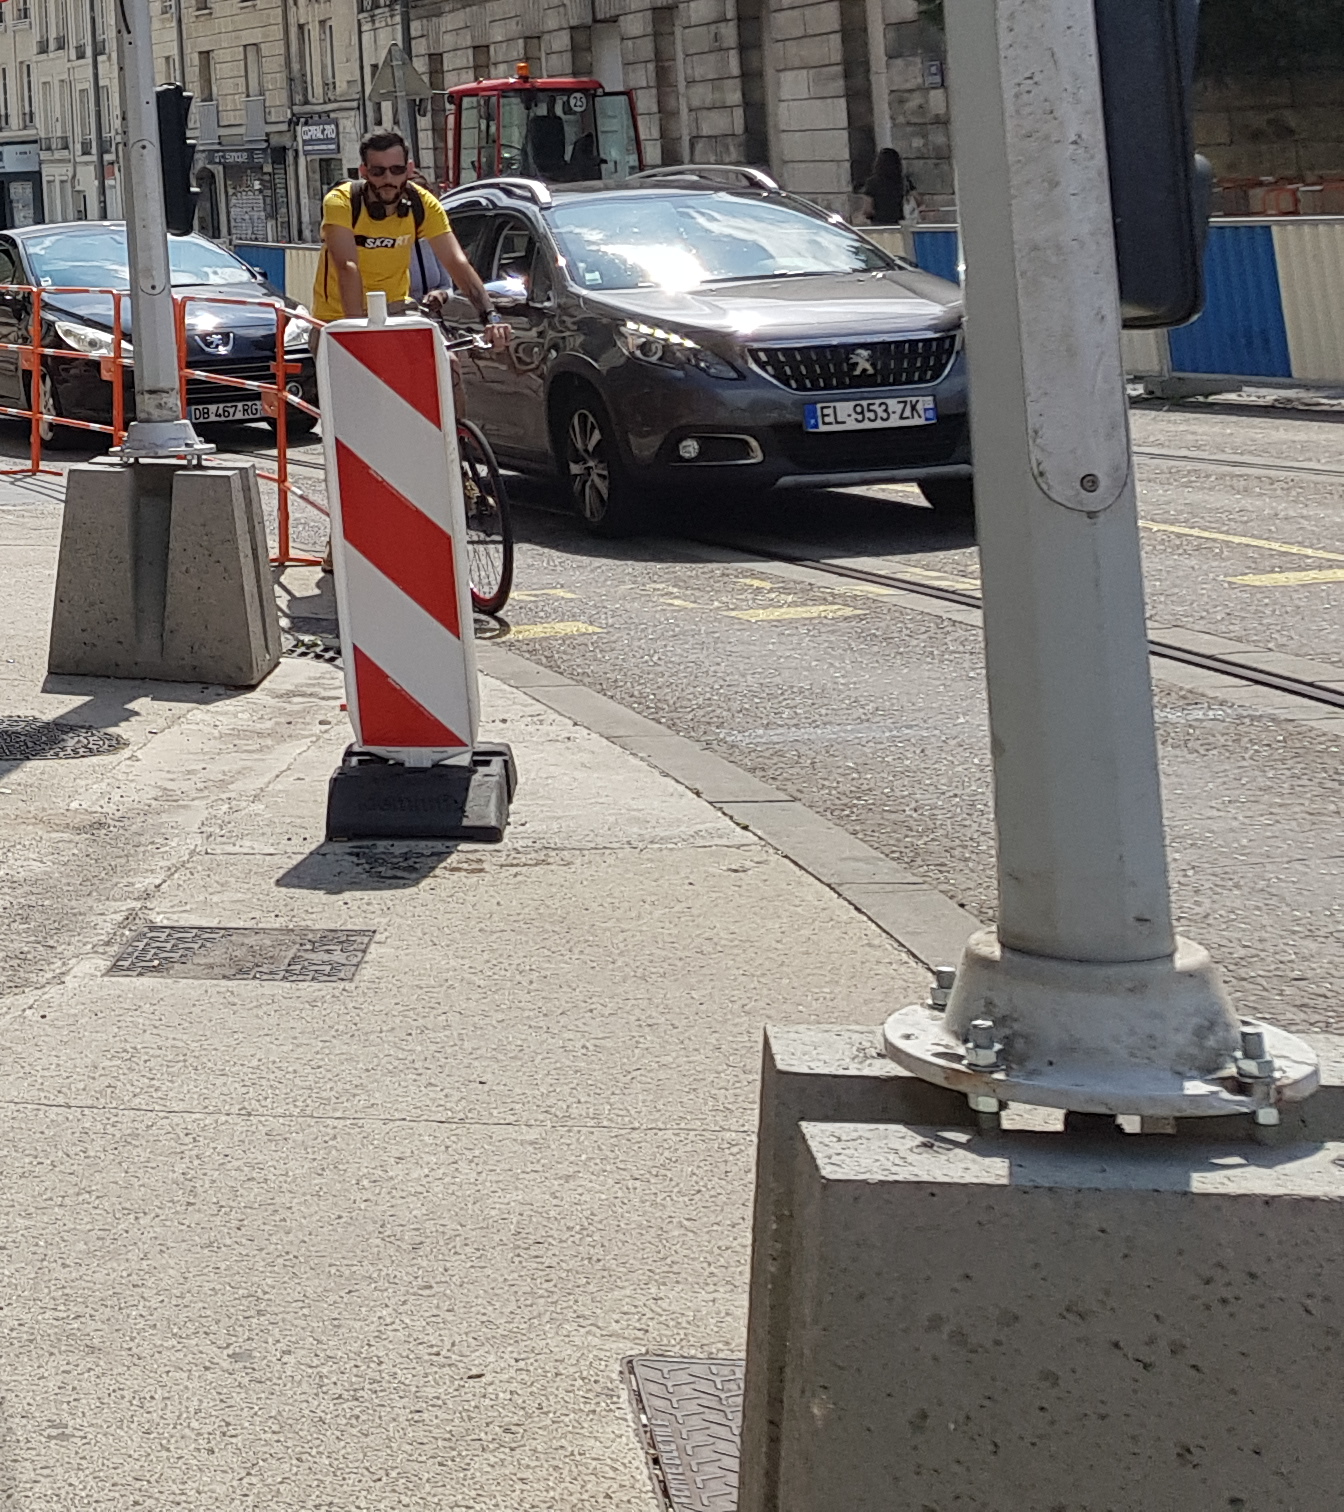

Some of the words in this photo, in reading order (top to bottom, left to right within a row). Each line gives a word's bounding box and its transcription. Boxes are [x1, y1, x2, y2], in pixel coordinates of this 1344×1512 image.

[572, 95, 584, 108] 25
[193, 402, 259, 421] DB-467-RG
[819, 399, 923, 426] EL-953-ZK
